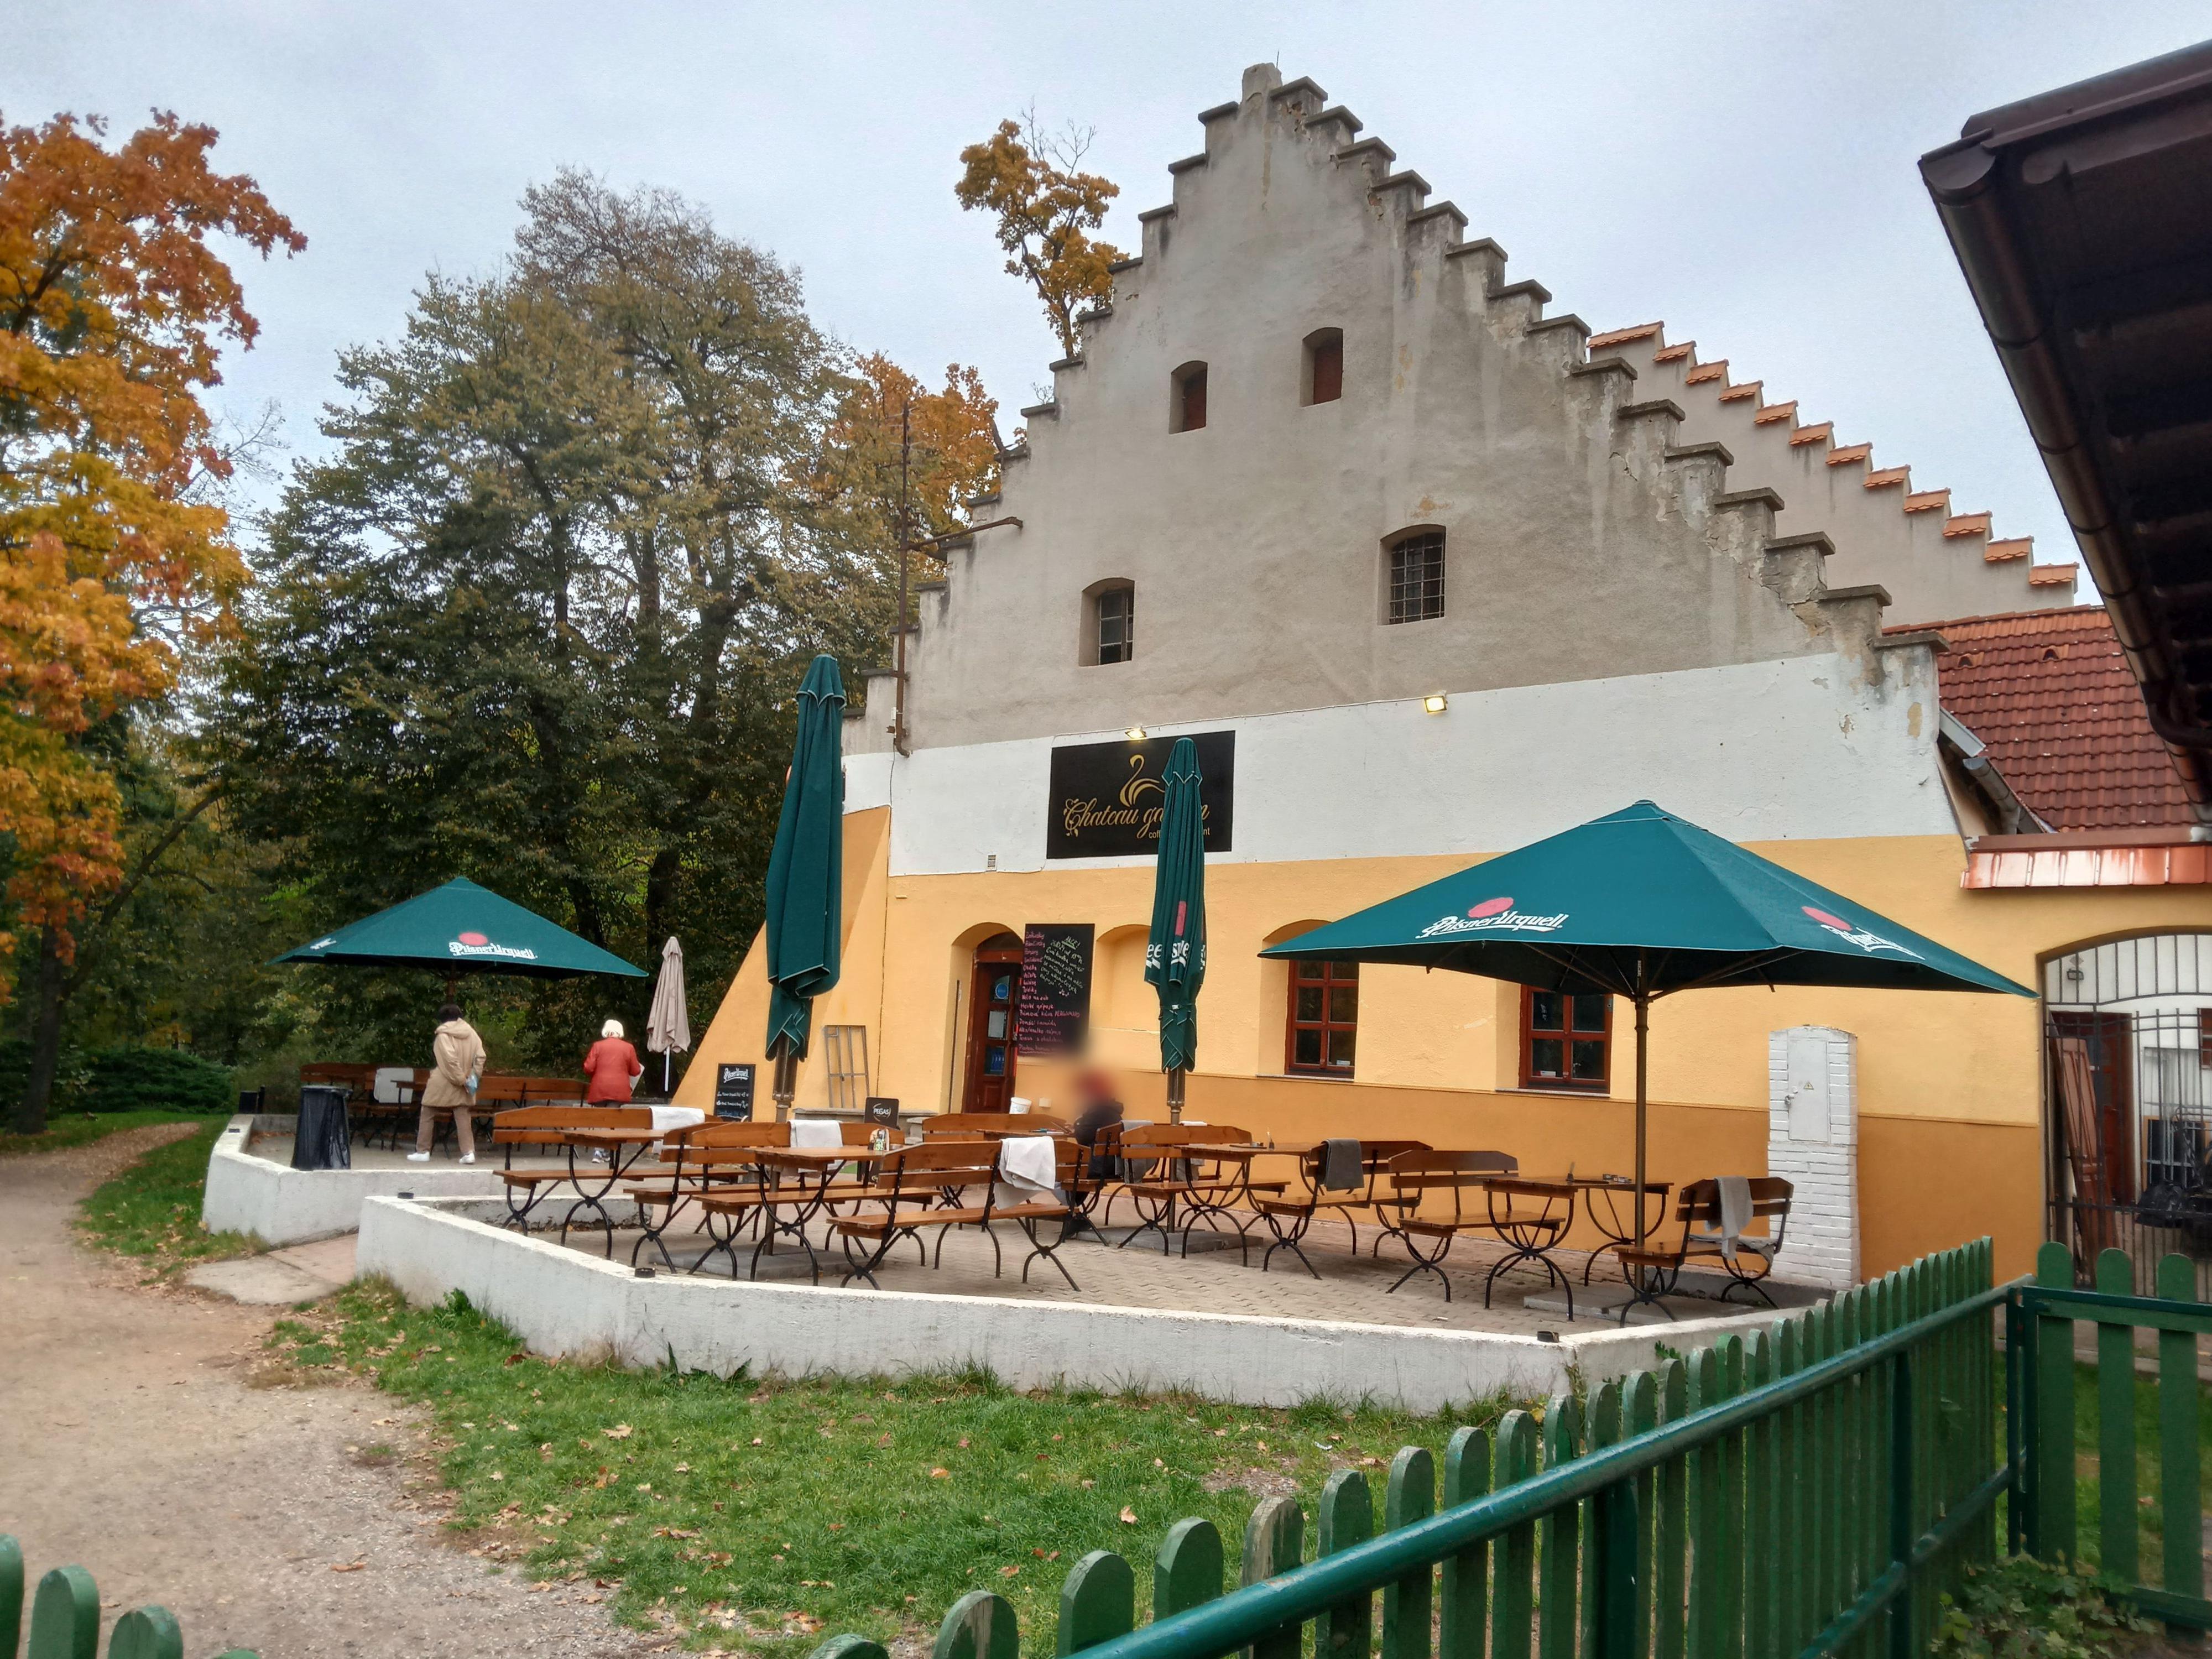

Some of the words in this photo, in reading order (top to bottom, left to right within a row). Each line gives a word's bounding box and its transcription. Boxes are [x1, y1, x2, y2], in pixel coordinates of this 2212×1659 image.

[1065, 797, 1139, 831] Chateau
[1415, 916, 1498, 939] Pilsner
[1495, 910, 1569, 932] Urquell
[449, 942, 493, 956] Pilsner
[492, 943, 538, 960] Urquell
